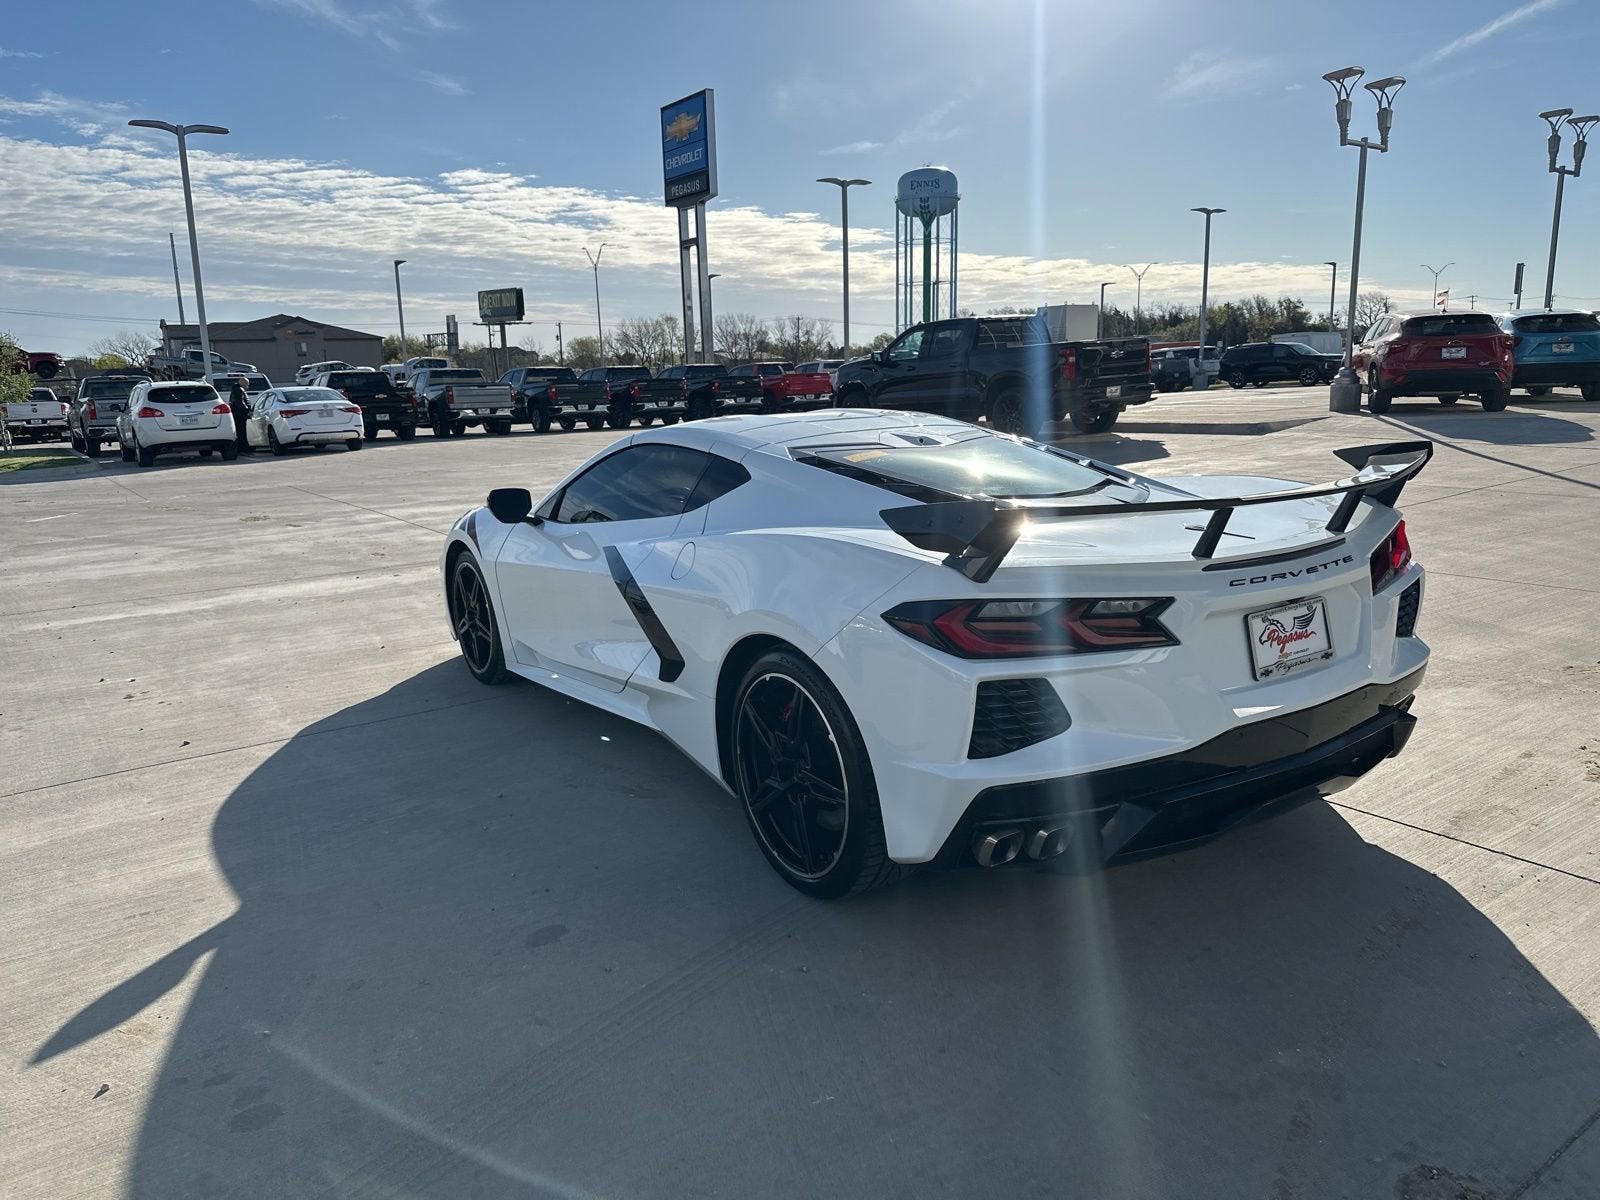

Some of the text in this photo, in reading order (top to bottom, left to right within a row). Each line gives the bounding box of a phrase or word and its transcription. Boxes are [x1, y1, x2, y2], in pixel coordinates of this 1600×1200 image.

[665, 148, 704, 170] CHEVROLET
[671, 180, 700, 197] PEGASUS
[910, 178, 940, 190] ENNIS
[488, 294, 501, 308] EXIT
[1229, 555, 1354, 587] CORVETTE
[1267, 629, 1317, 654] Pegasus
[1275, 657, 1318, 675] Pegasus
